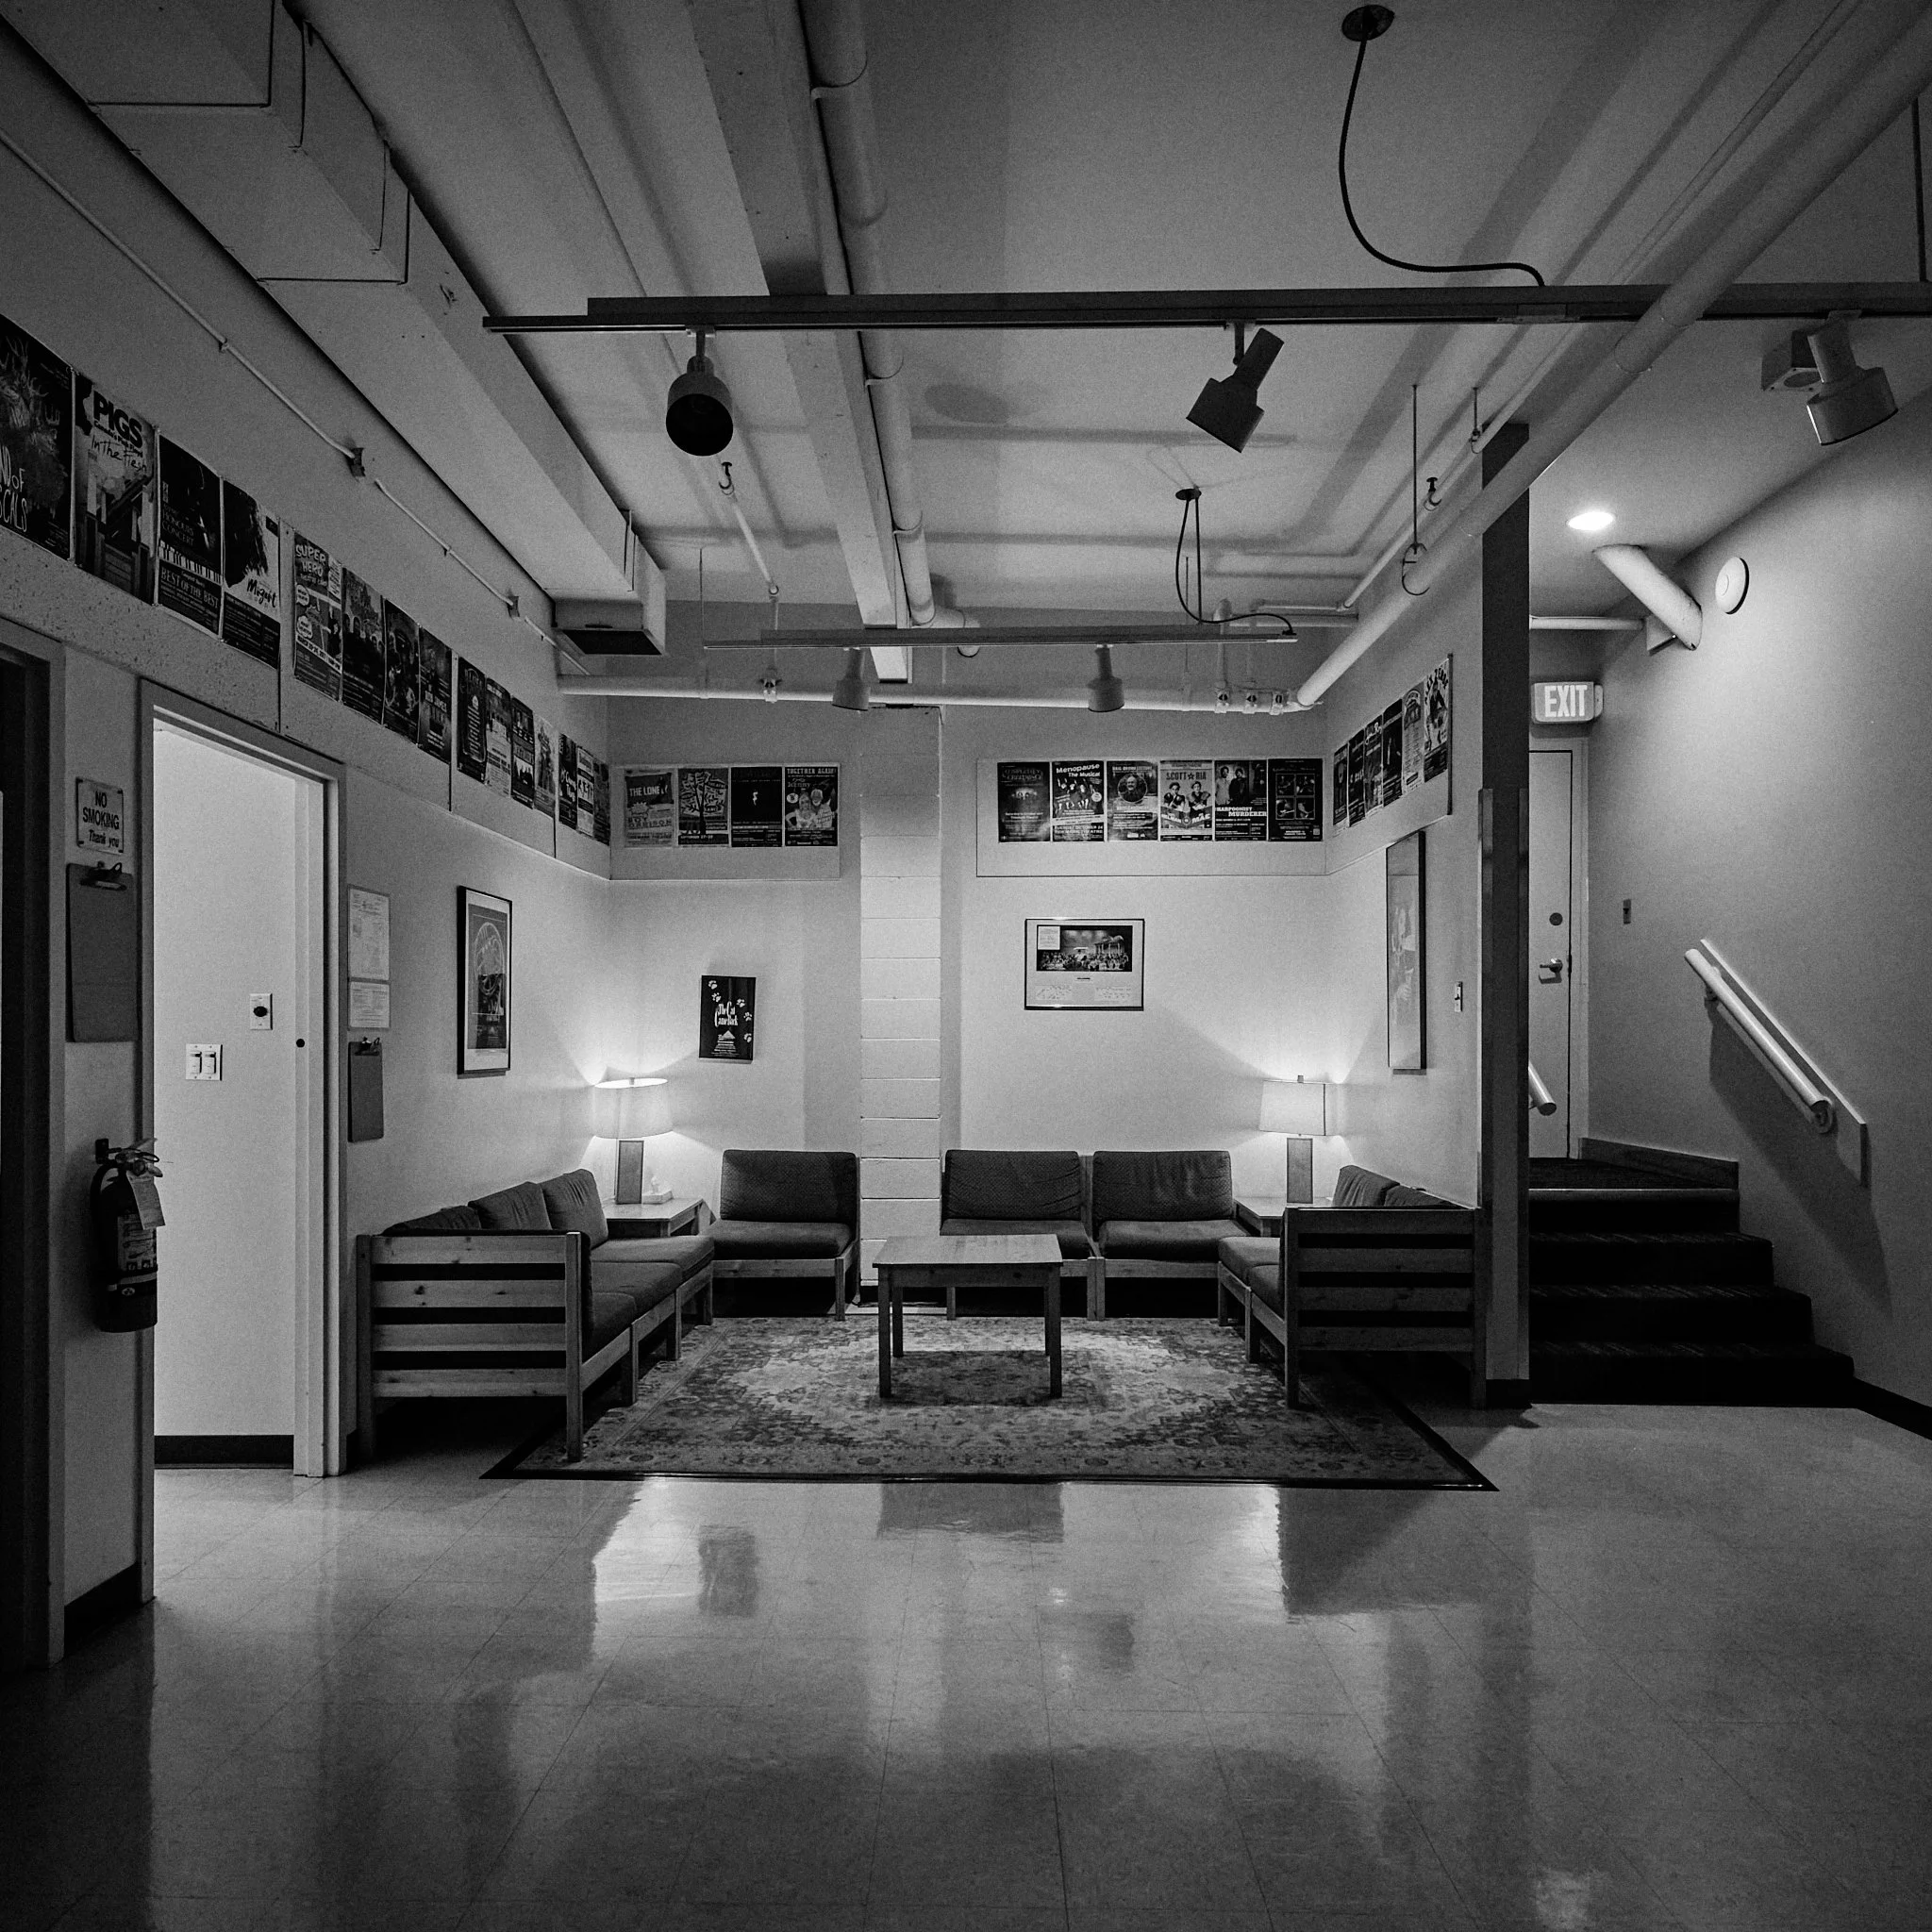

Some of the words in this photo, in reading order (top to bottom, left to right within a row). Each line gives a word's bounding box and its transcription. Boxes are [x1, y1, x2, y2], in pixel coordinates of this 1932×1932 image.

[93, 391, 142, 449] PIGS
[161, 520, 194, 546] CONCERT
[295, 544, 326, 566] SUPER
[301, 560, 324, 577] HERO
[160, 567, 180, 588] BEST
[203, 590, 220, 608] BEST
[246, 577, 276, 608] Mozart
[1544, 684, 1588, 717] EXIT
[1056, 763, 1100, 774] Menopause
[1166, 772, 1187, 780] SCOTT
[1195, 772, 1207, 780] RIA
[95, 791, 108, 808] NO
[629, 787, 642, 797] THE
[82, 807, 120, 830] SMOKING
[89, 829, 107, 844] Thank
[108, 837, 120, 848] you
[726, 1001, 736, 1017] Cat
